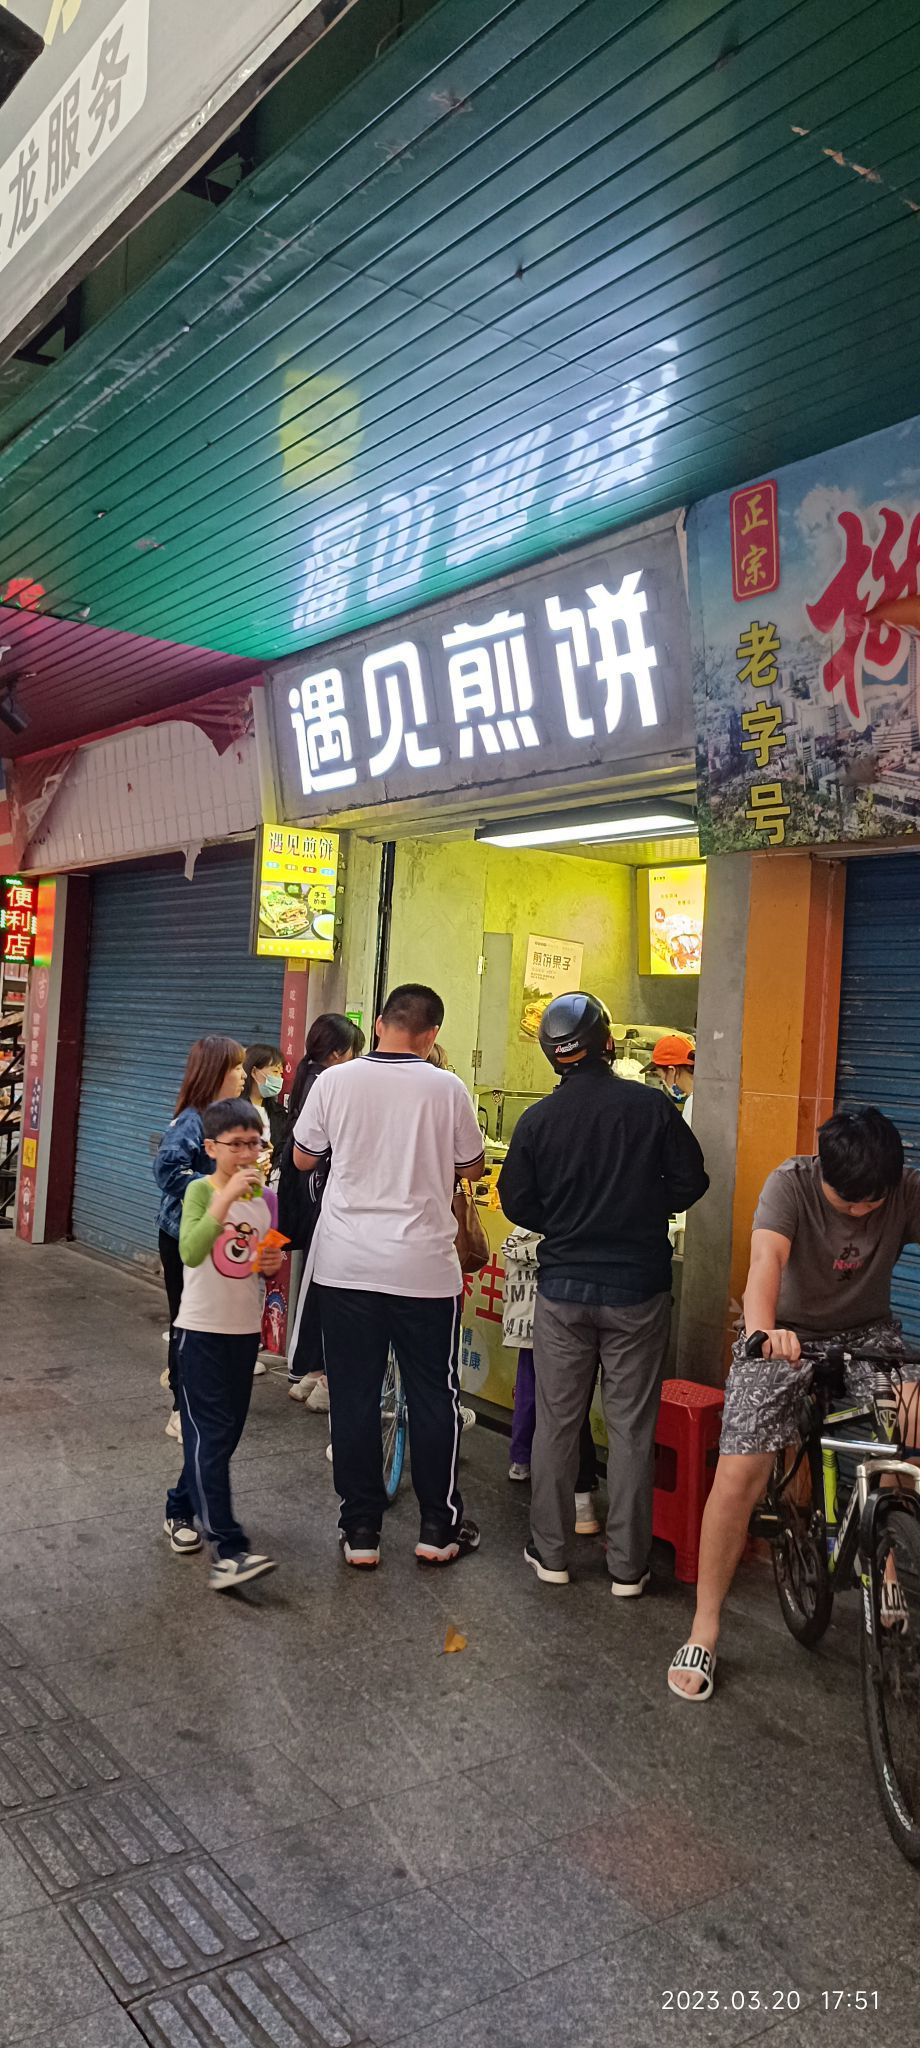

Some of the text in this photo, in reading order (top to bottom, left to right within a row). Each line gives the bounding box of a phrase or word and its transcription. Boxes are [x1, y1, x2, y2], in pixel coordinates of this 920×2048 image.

[0, 24, 129, 248] 龙服务
[740, 494, 769, 588] 正宗
[288, 567, 659, 795] 遇见煎饼
[736, 620, 792, 846] 老字号
[268, 831, 334, 860] 遇见煎饼
[4, 885, 34, 956] 便利店
[532, 951, 572, 971] 煎饼果子
